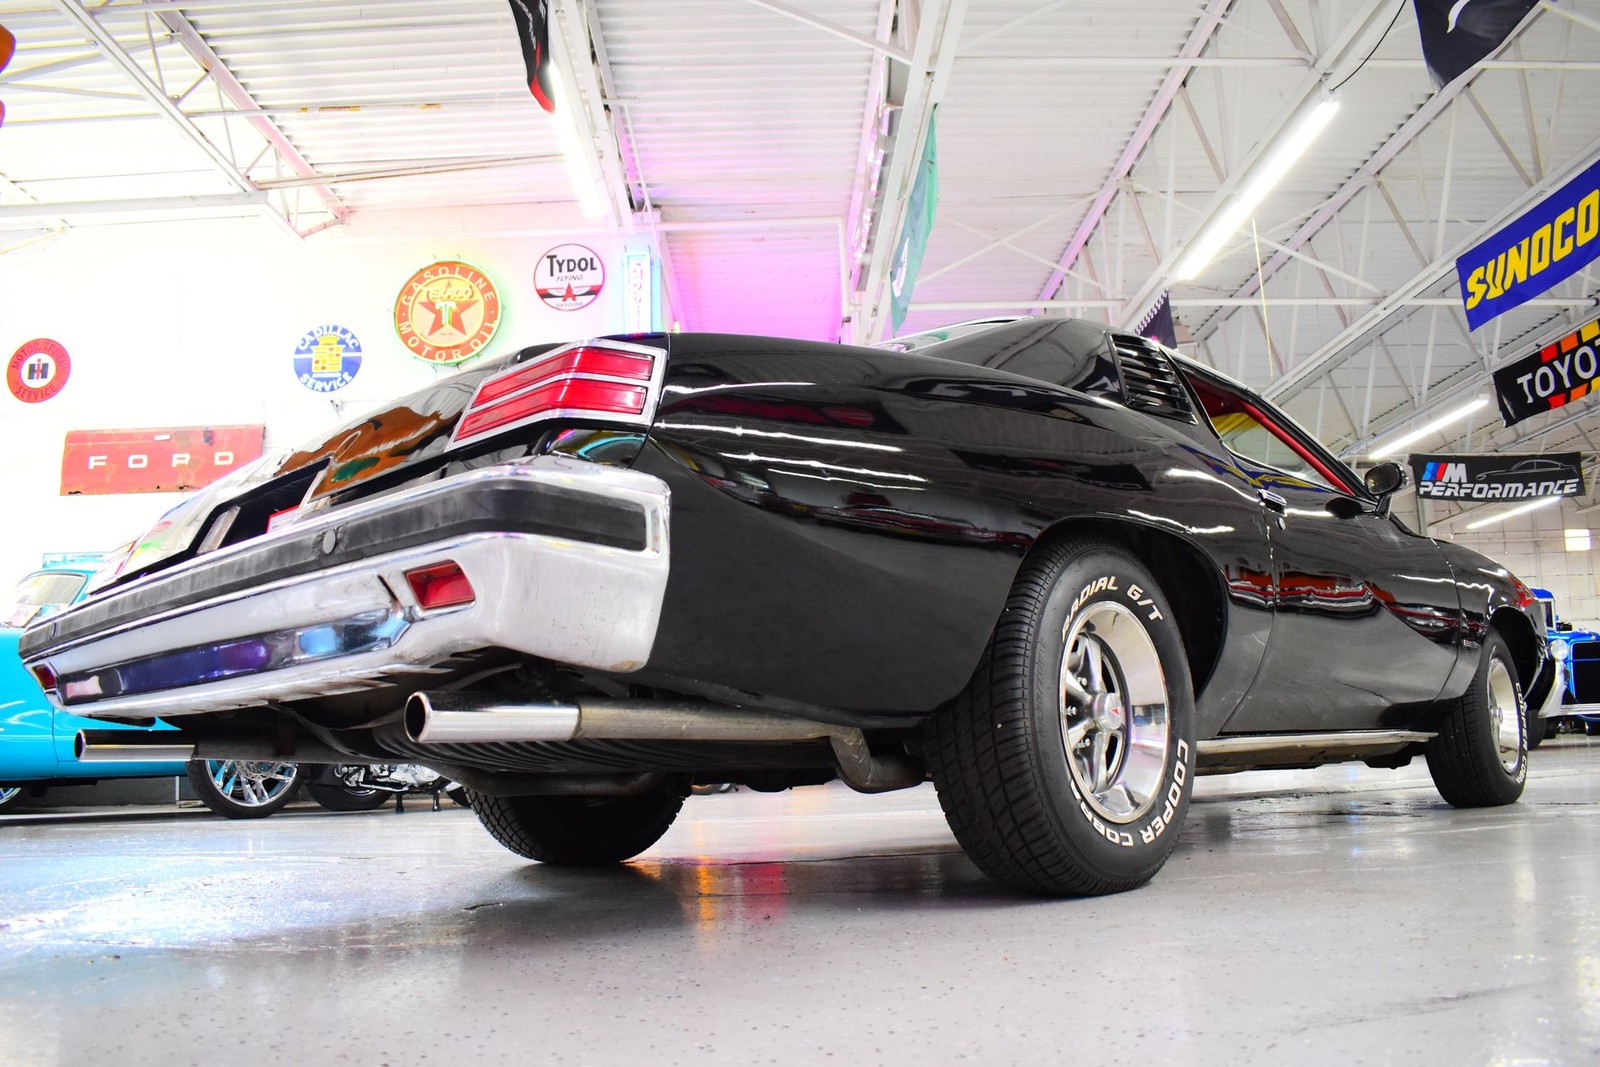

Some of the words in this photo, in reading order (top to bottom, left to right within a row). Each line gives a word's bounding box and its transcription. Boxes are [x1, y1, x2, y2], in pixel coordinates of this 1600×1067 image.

[1465, 188, 1600, 311] SUNOCO
[546, 254, 597, 277] TYDOL
[401, 265, 496, 306] GASOLINE
[556, 274, 584, 282] FLYING
[422, 285, 474, 300] TEXACO
[298, 324, 360, 351] CADILLAC
[398, 320, 463, 361] MOTOR
[469, 319, 499, 350] OIL
[15, 384, 58, 401] SERVICE
[299, 371, 353, 392] SERVICE
[88, 451, 235, 469] FORD
[1419, 478, 1580, 499] PERFORMANCE
[1061, 575, 1119, 643] RADIAL
[1126, 583, 1164, 625] G/T
[1139, 738, 1190, 845] COOPER
